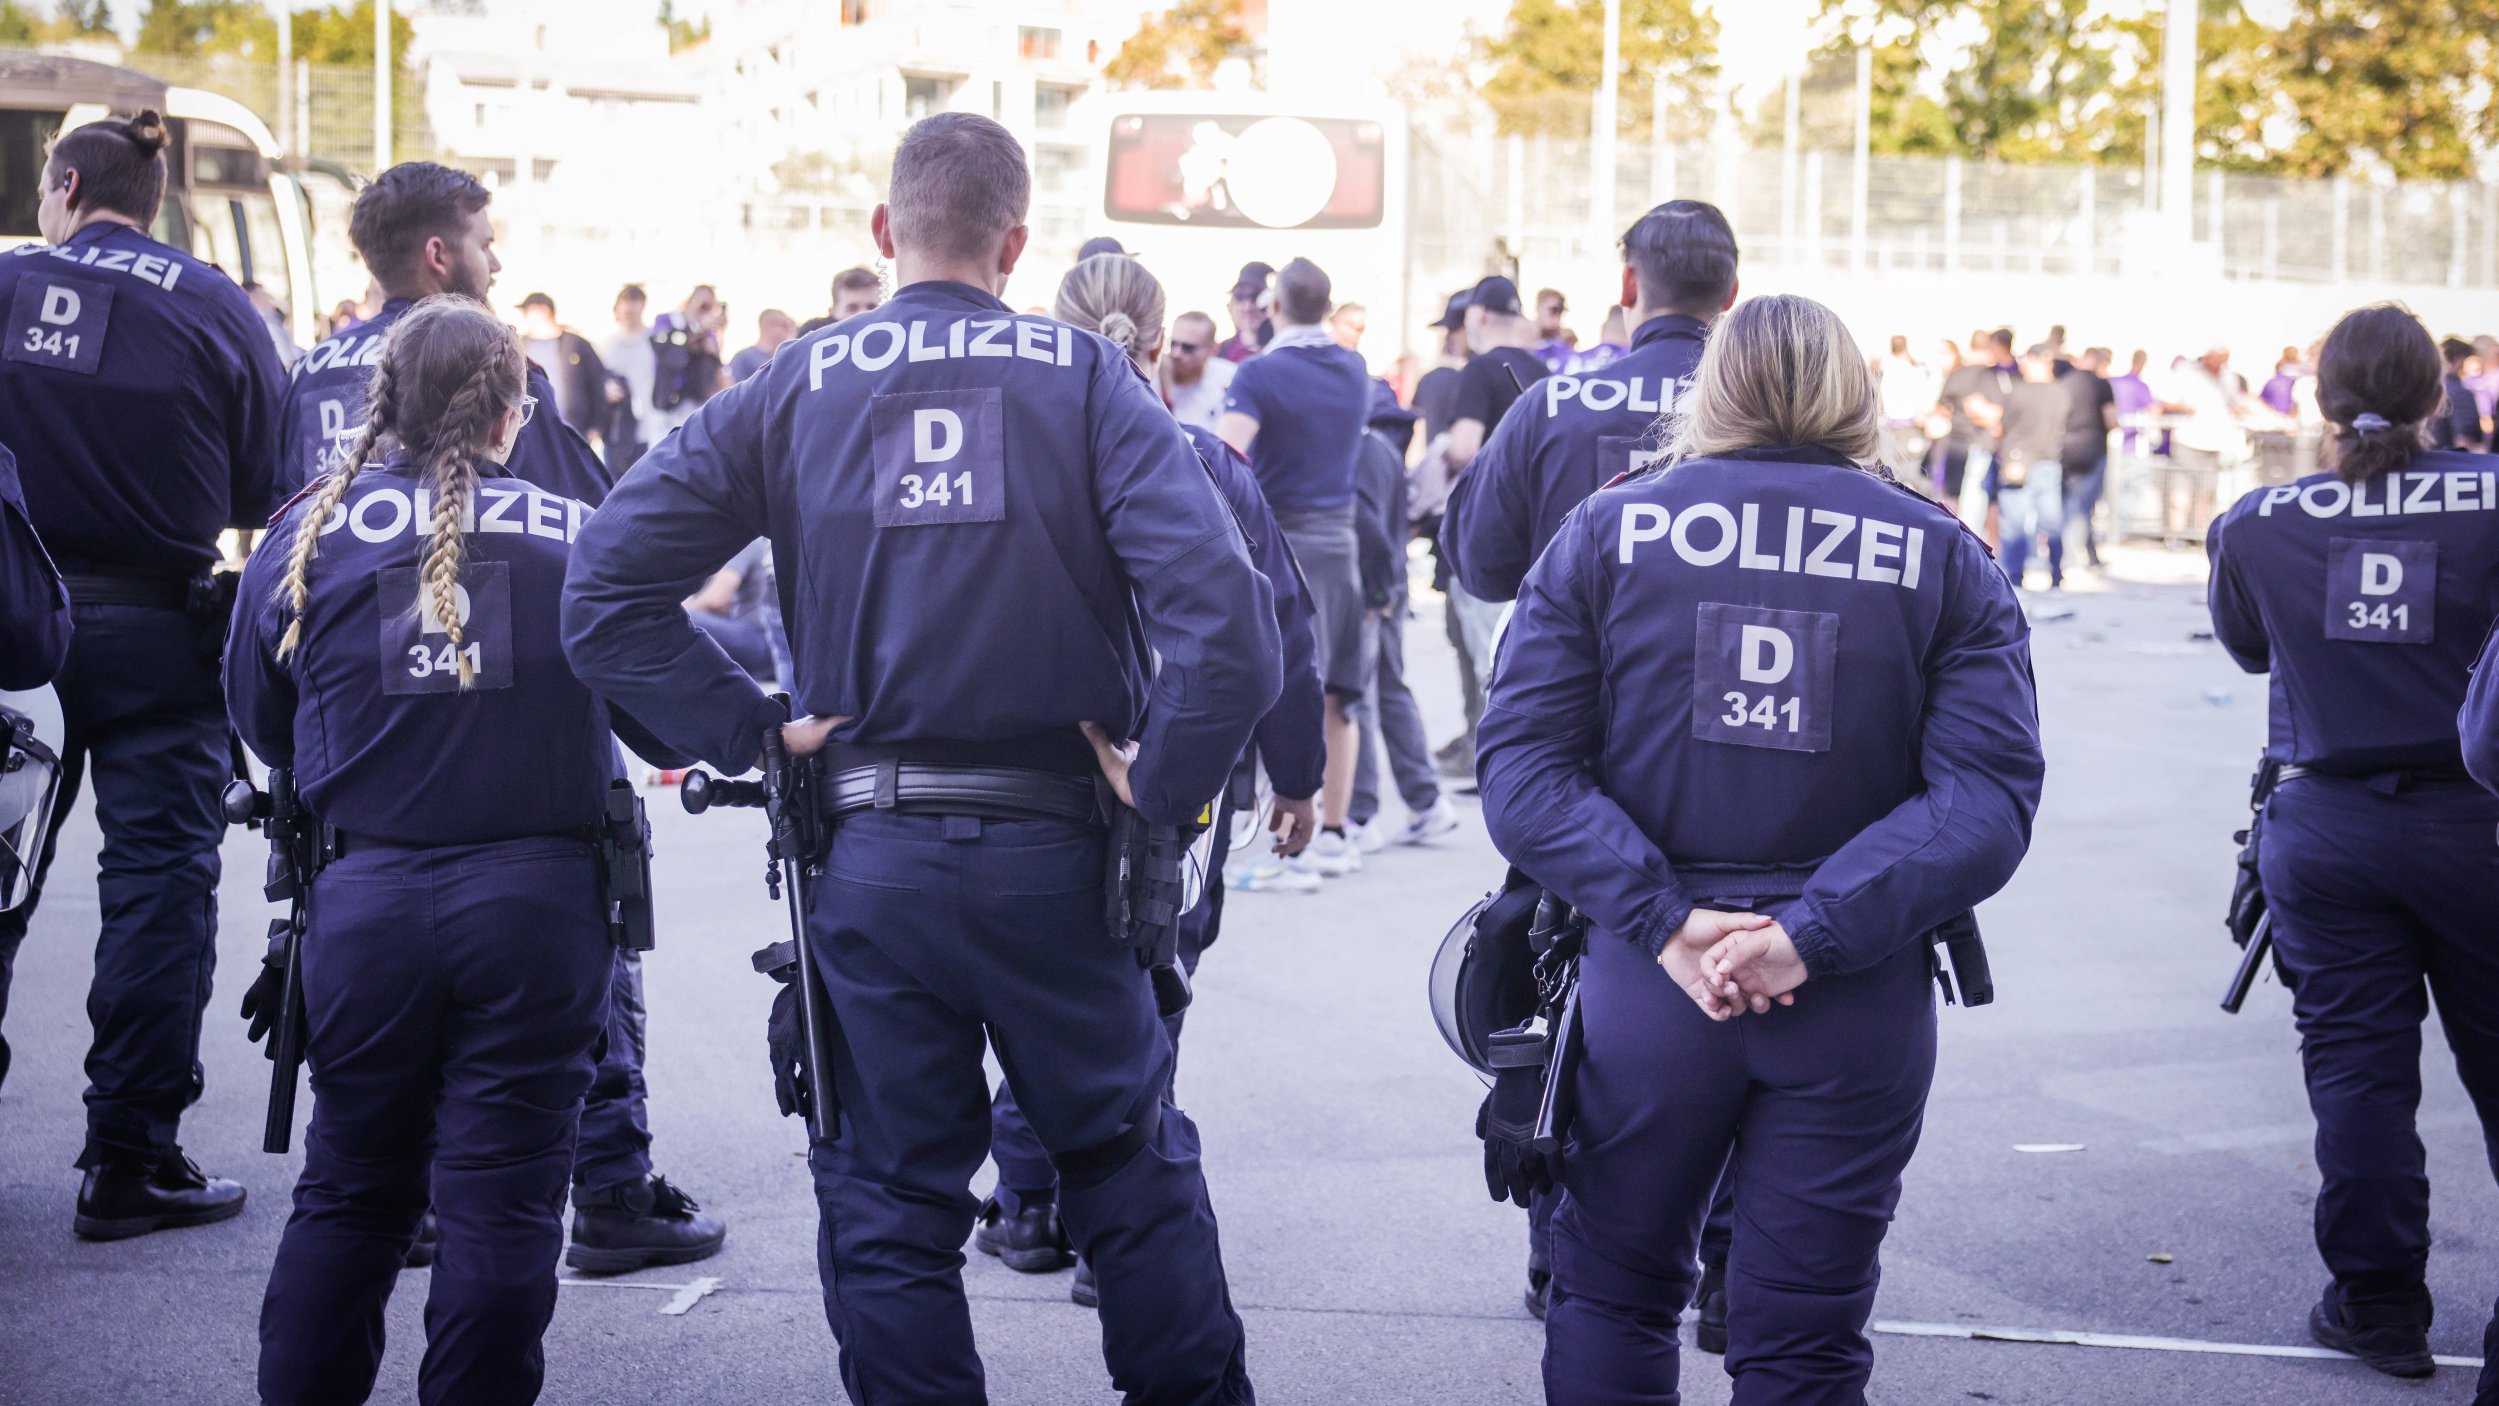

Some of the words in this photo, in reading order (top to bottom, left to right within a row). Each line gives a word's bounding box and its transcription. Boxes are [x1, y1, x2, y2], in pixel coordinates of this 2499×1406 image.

[40, 284, 81, 325] D
[24, 327, 80, 359] 341
[809, 318, 1072, 391] POLIZEI
[320, 399, 344, 440] D
[914, 408, 963, 463] D
[316, 443, 346, 473] 34
[900, 471, 973, 508] 341
[2258, 472, 2497, 519] POLIZEI
[1619, 502, 1924, 589] POLIZEI
[2361, 553, 2404, 596] D
[2347, 601, 2409, 631] 341
[408, 641, 482, 678] 341
[1739, 624, 1795, 684] D
[1721, 691, 1801, 733] 341
